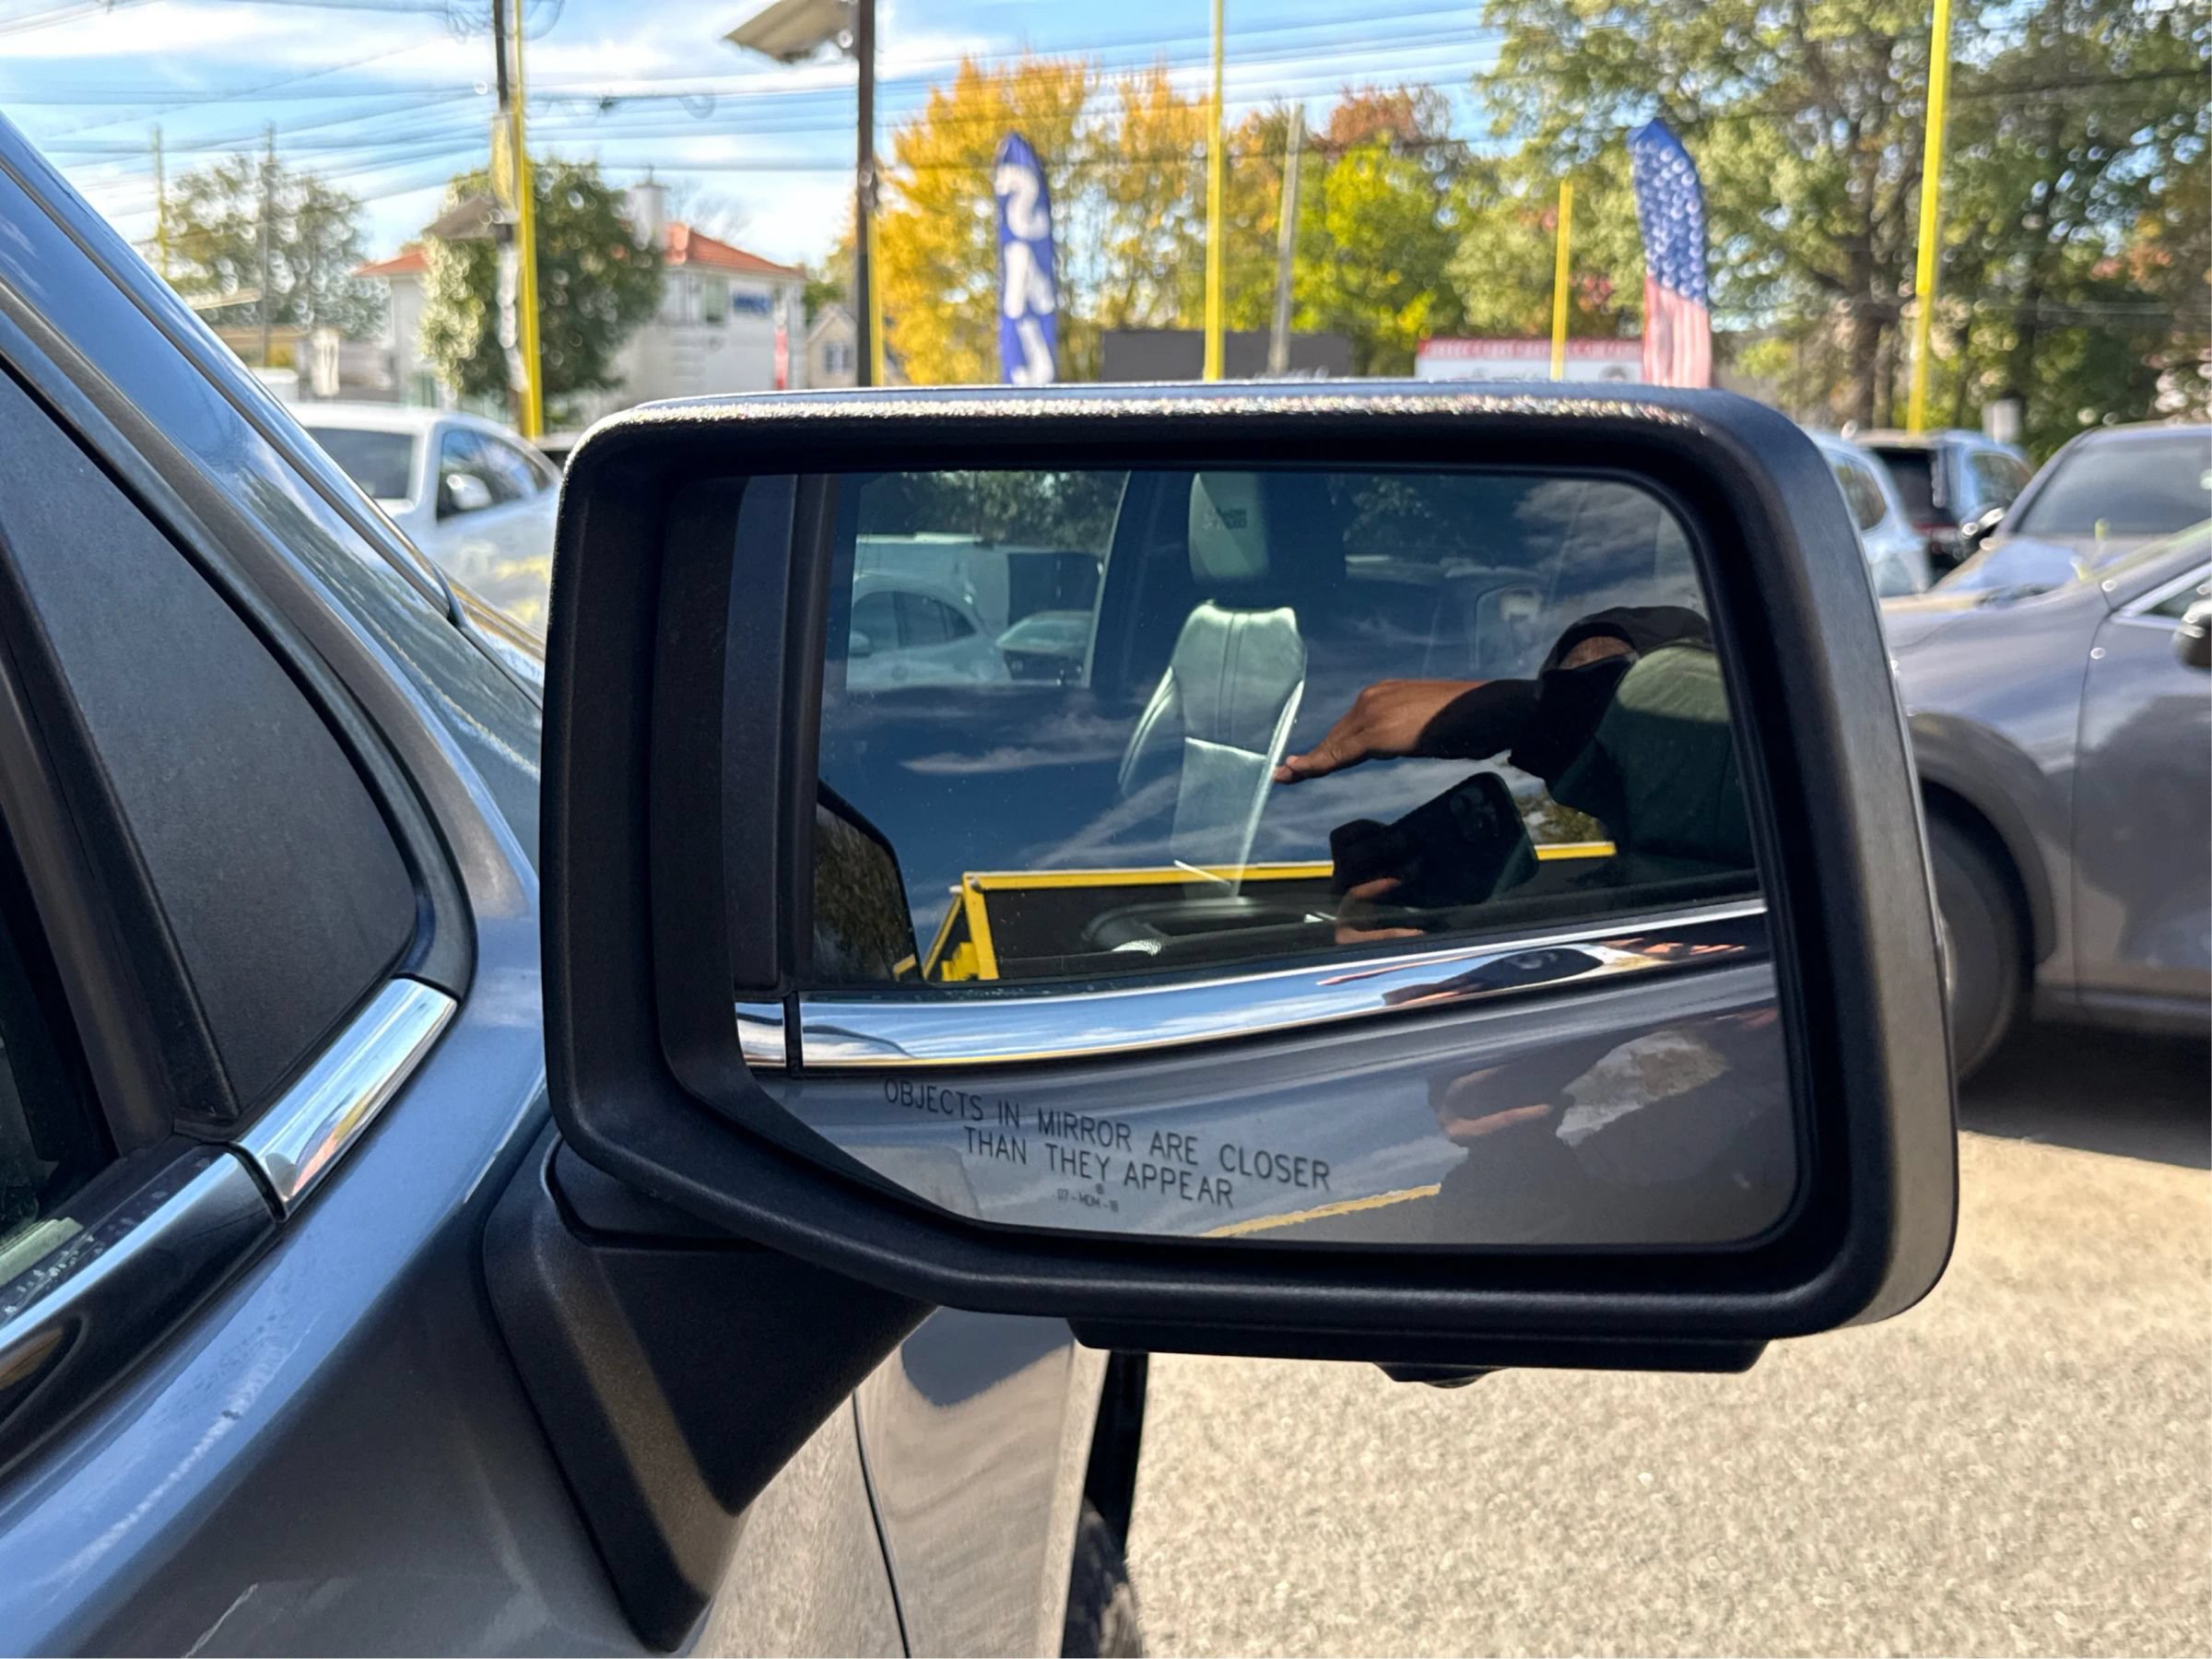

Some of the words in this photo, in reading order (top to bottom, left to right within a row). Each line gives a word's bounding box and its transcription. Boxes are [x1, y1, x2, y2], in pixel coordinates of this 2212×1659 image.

[884, 1077, 984, 1122] OBJECTS
[997, 1099, 1020, 1129] IN
[1037, 1106, 1133, 1152] MIRROR
[1149, 1130, 1198, 1166] ARE
[1218, 1143, 1331, 1192] CLOSER
[963, 1125, 1027, 1166] THAN
[1044, 1142, 1111, 1182] THEY
[1123, 1160, 1234, 1209] APPEAR
